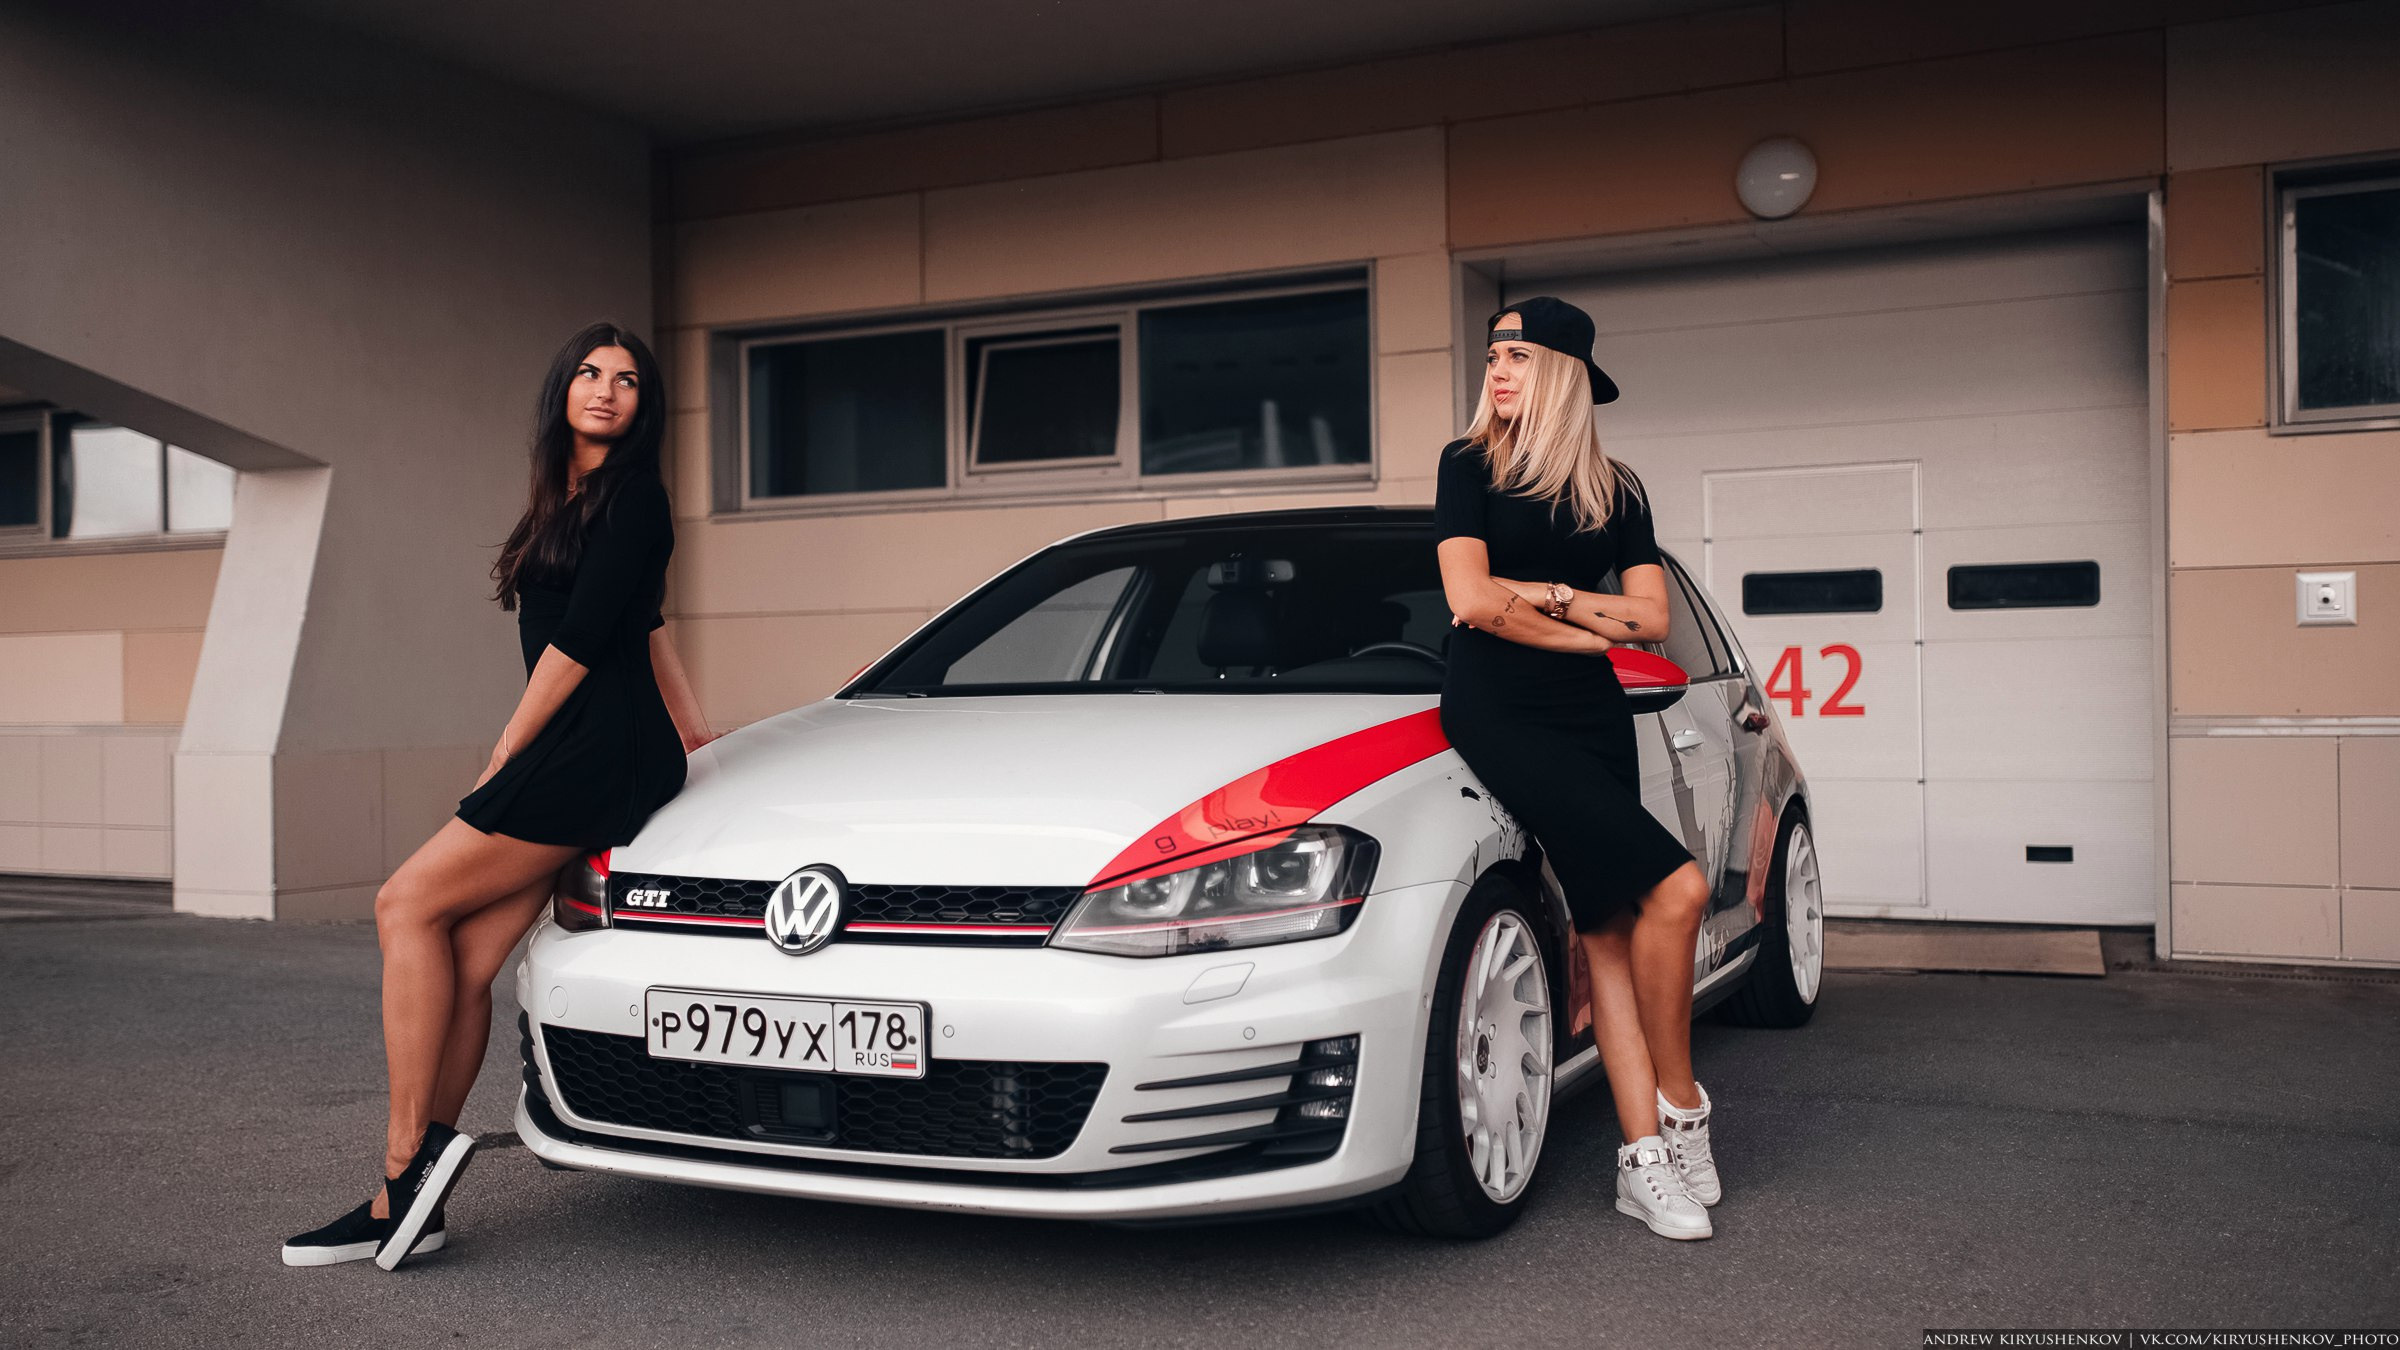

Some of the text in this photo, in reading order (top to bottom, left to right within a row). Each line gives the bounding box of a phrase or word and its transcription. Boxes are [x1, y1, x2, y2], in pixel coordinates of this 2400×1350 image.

[1764, 643, 1865, 716] 42
[625, 888, 671, 908] GTI
[768, 876, 838, 948] VW
[838, 1010, 908, 1051] 178
[855, 1052, 890, 1067] RUS
